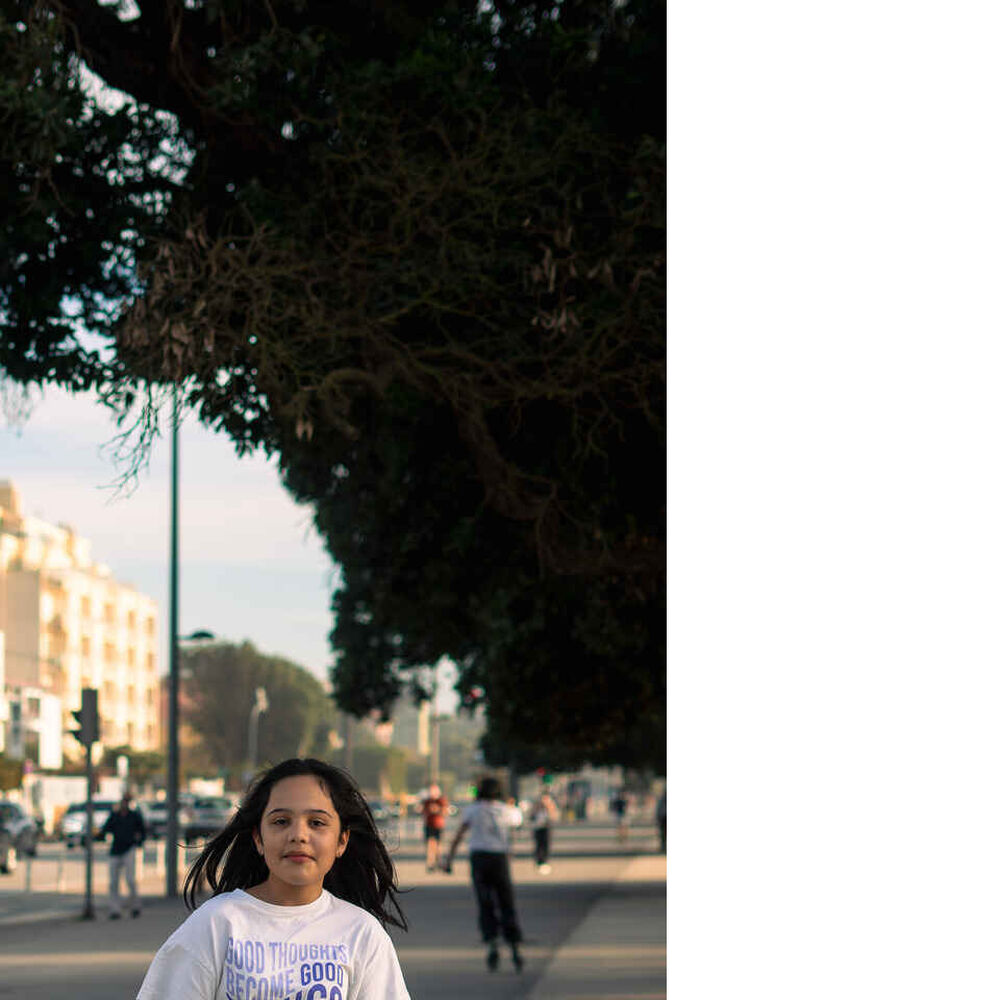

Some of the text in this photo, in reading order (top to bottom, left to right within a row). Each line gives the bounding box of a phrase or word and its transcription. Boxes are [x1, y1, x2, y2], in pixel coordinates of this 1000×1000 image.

[226, 937, 348, 973] GOOD THOUGHTS
[301, 962, 343, 988] GOOD
